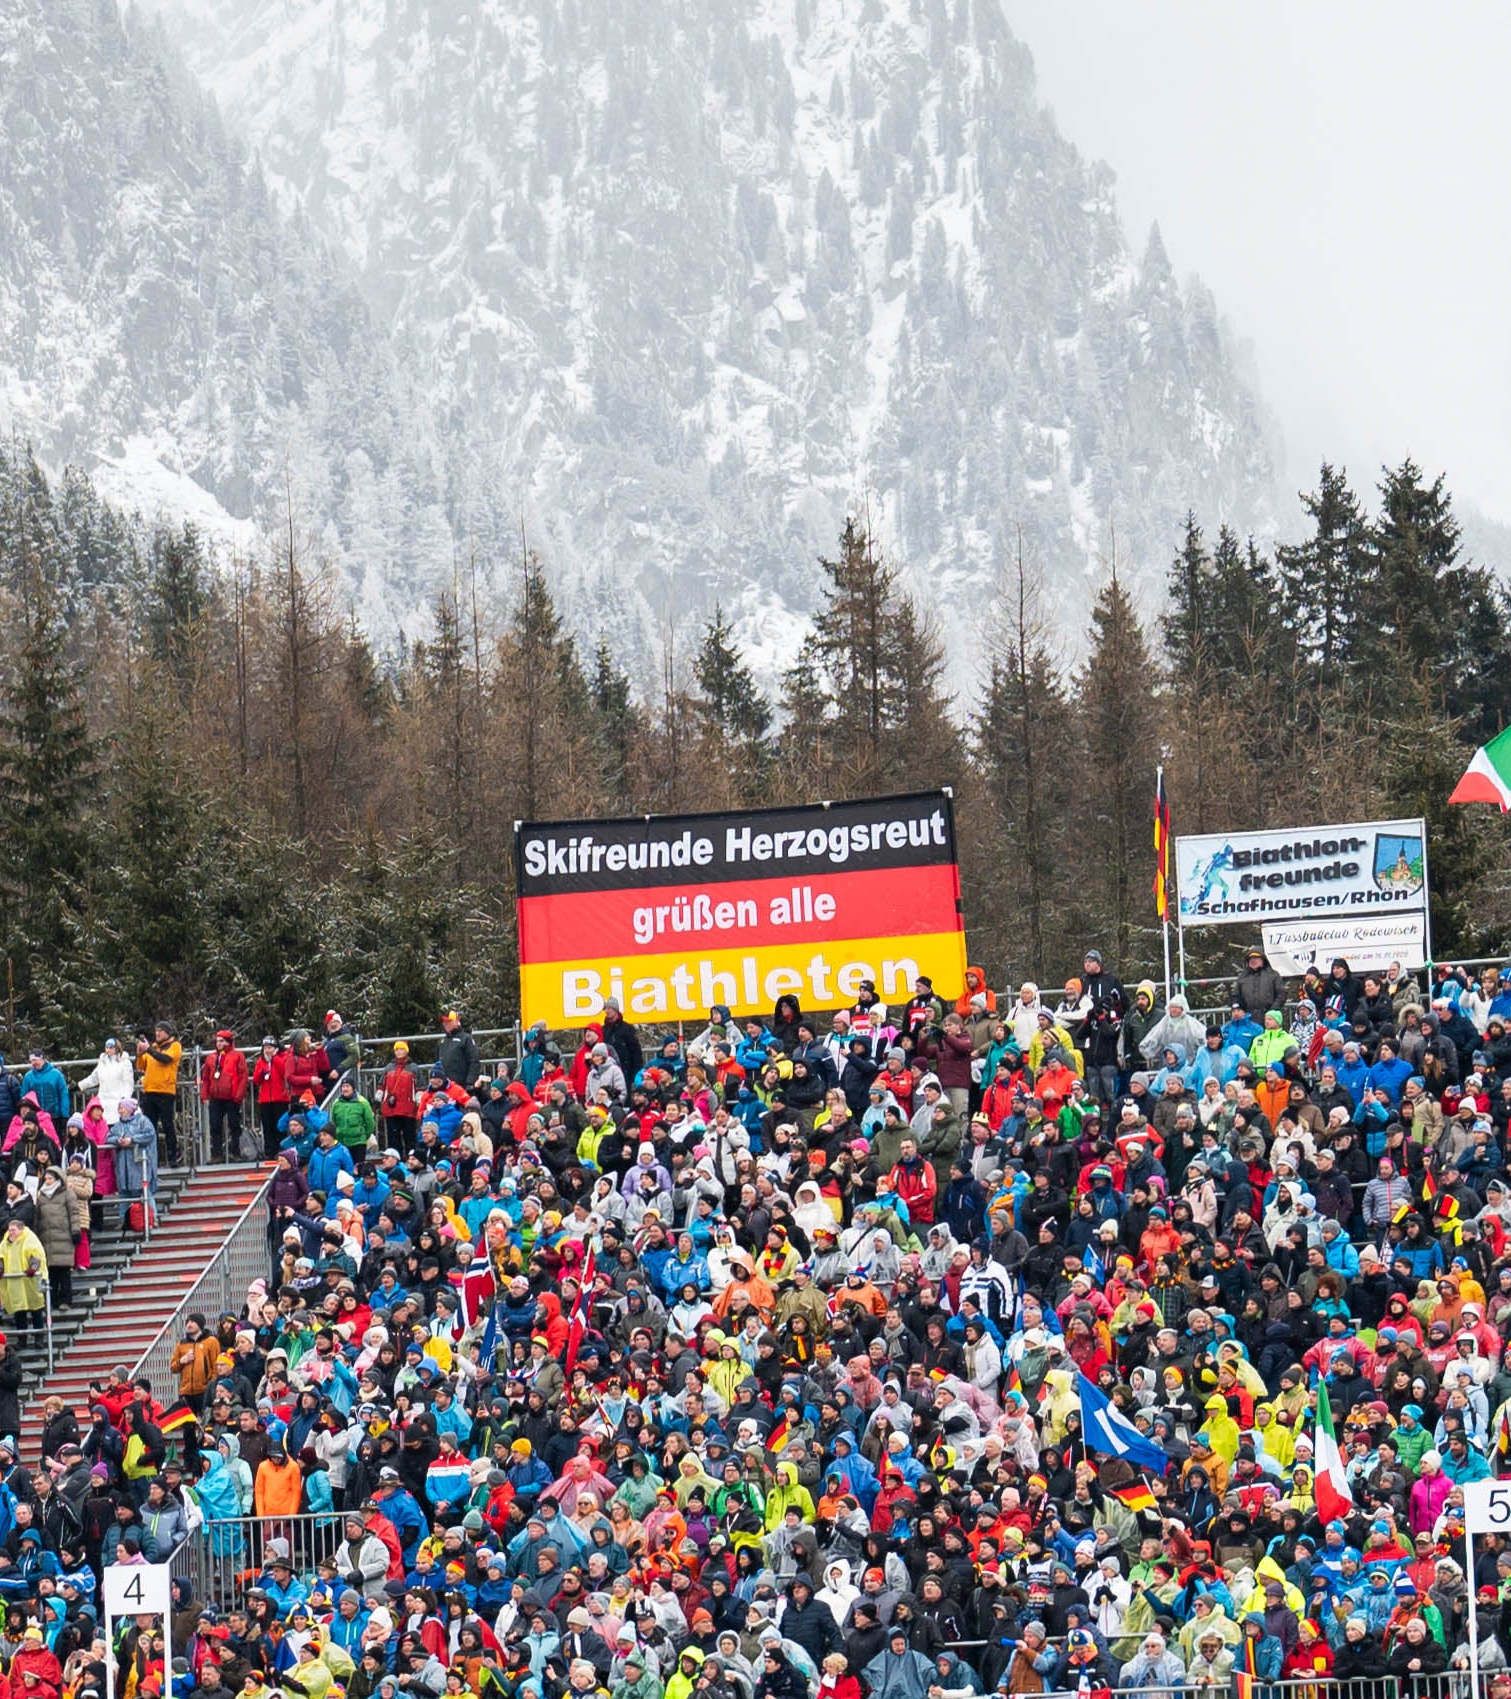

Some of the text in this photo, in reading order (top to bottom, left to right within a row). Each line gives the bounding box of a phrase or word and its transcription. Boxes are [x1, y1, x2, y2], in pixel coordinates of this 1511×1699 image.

[524, 808, 946, 877] Skifreunde Herzogsreut
[1232, 837, 1367, 868] Biathlon-
[1239, 861, 1360, 892] freunde
[632, 886, 837, 944] grüßen alle
[1197, 887, 1408, 915] Schafhausen/Rhön
[562, 953, 920, 1018] Biathleten
[1488, 1489, 1511, 1524] 5
[123, 1573, 145, 1605] 4
